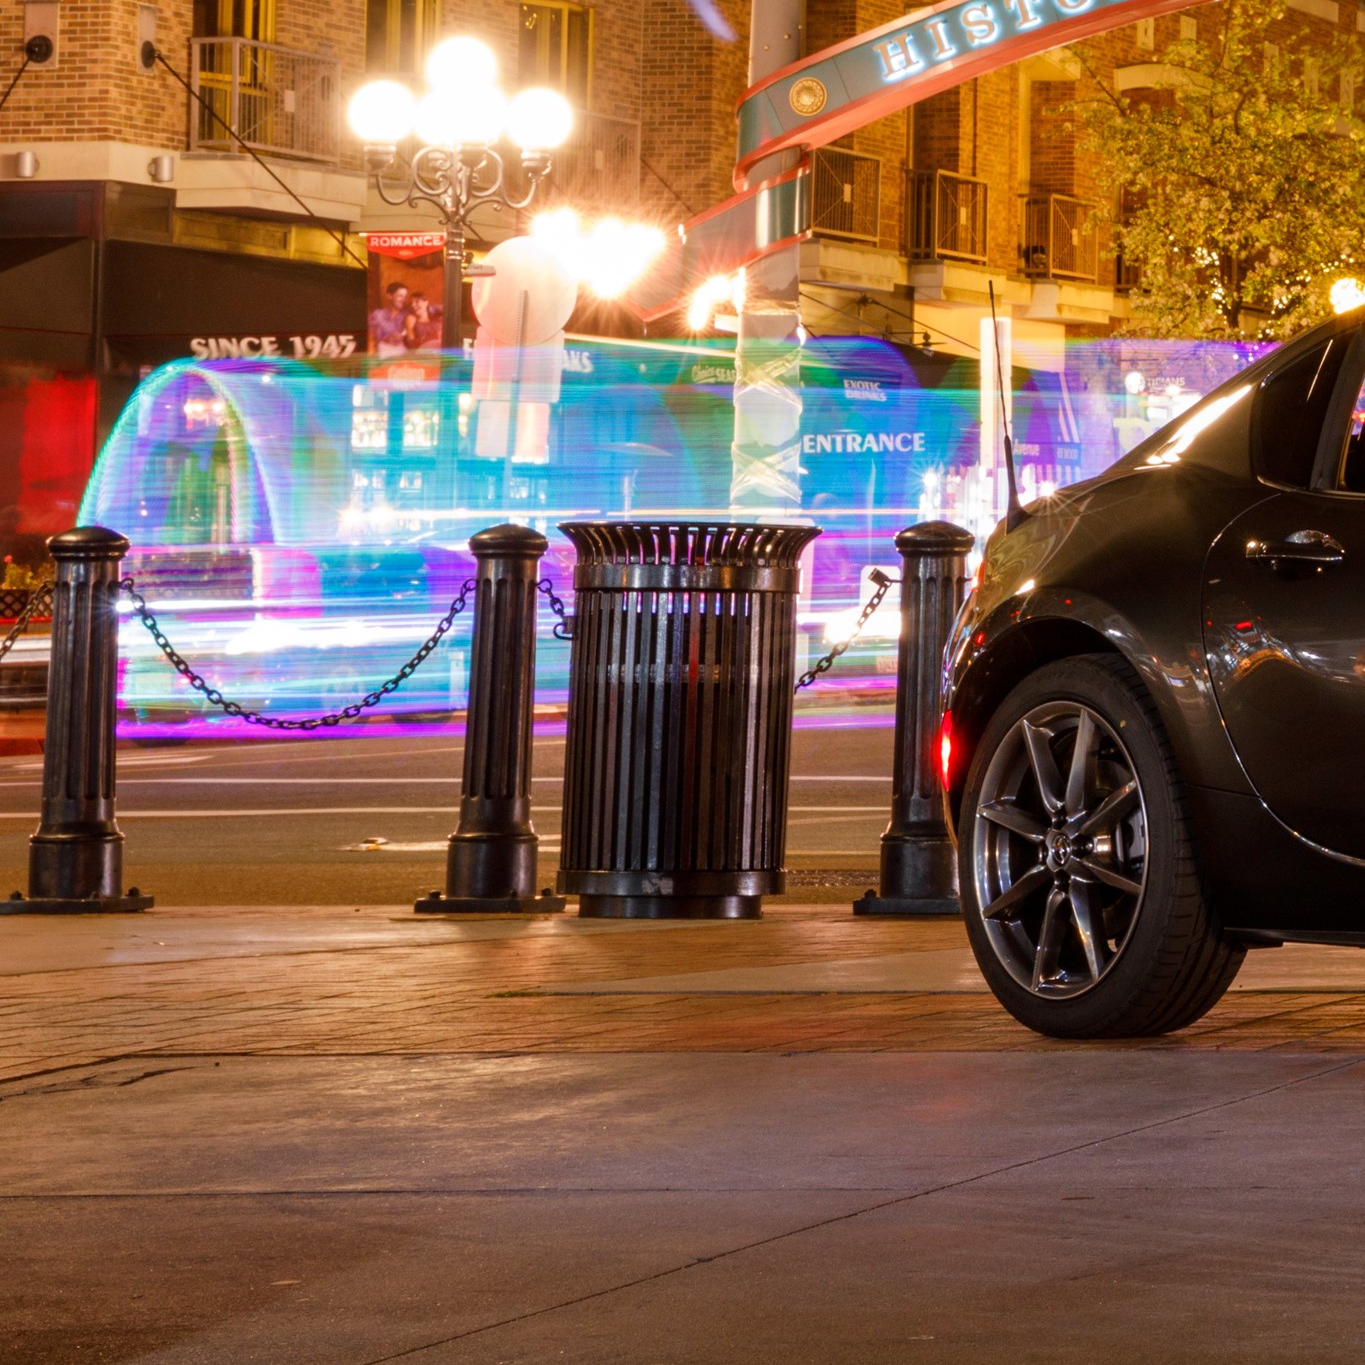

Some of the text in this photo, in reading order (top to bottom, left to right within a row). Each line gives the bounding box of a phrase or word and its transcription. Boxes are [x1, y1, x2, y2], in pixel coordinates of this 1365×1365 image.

[370, 236, 441, 247] ROMANCE
[190, 335, 357, 360] SINCE 1945
[843, 380, 880, 390] EXOTIC
[845, 390, 887, 401] DRINKS
[803, 433, 926, 453] ENTRANCE
